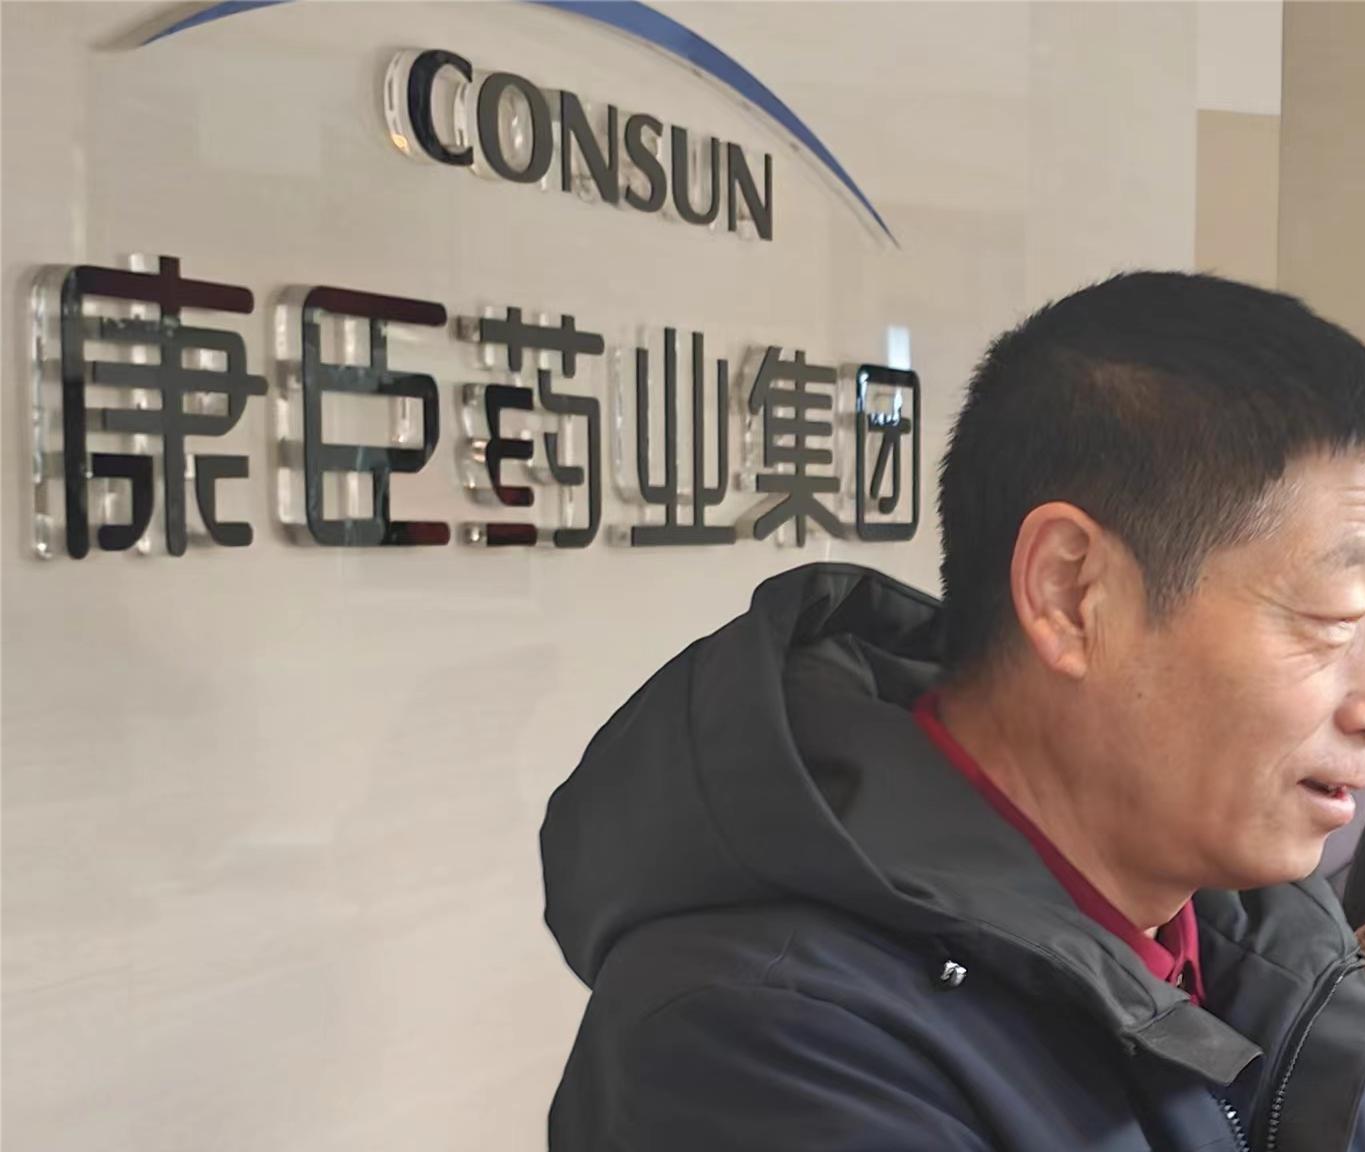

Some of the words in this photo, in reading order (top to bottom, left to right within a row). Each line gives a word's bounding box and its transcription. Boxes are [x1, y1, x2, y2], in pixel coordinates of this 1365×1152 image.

[396, 46, 774, 242] CONSUN
[44, 253, 921, 559] 康臣药业集团
